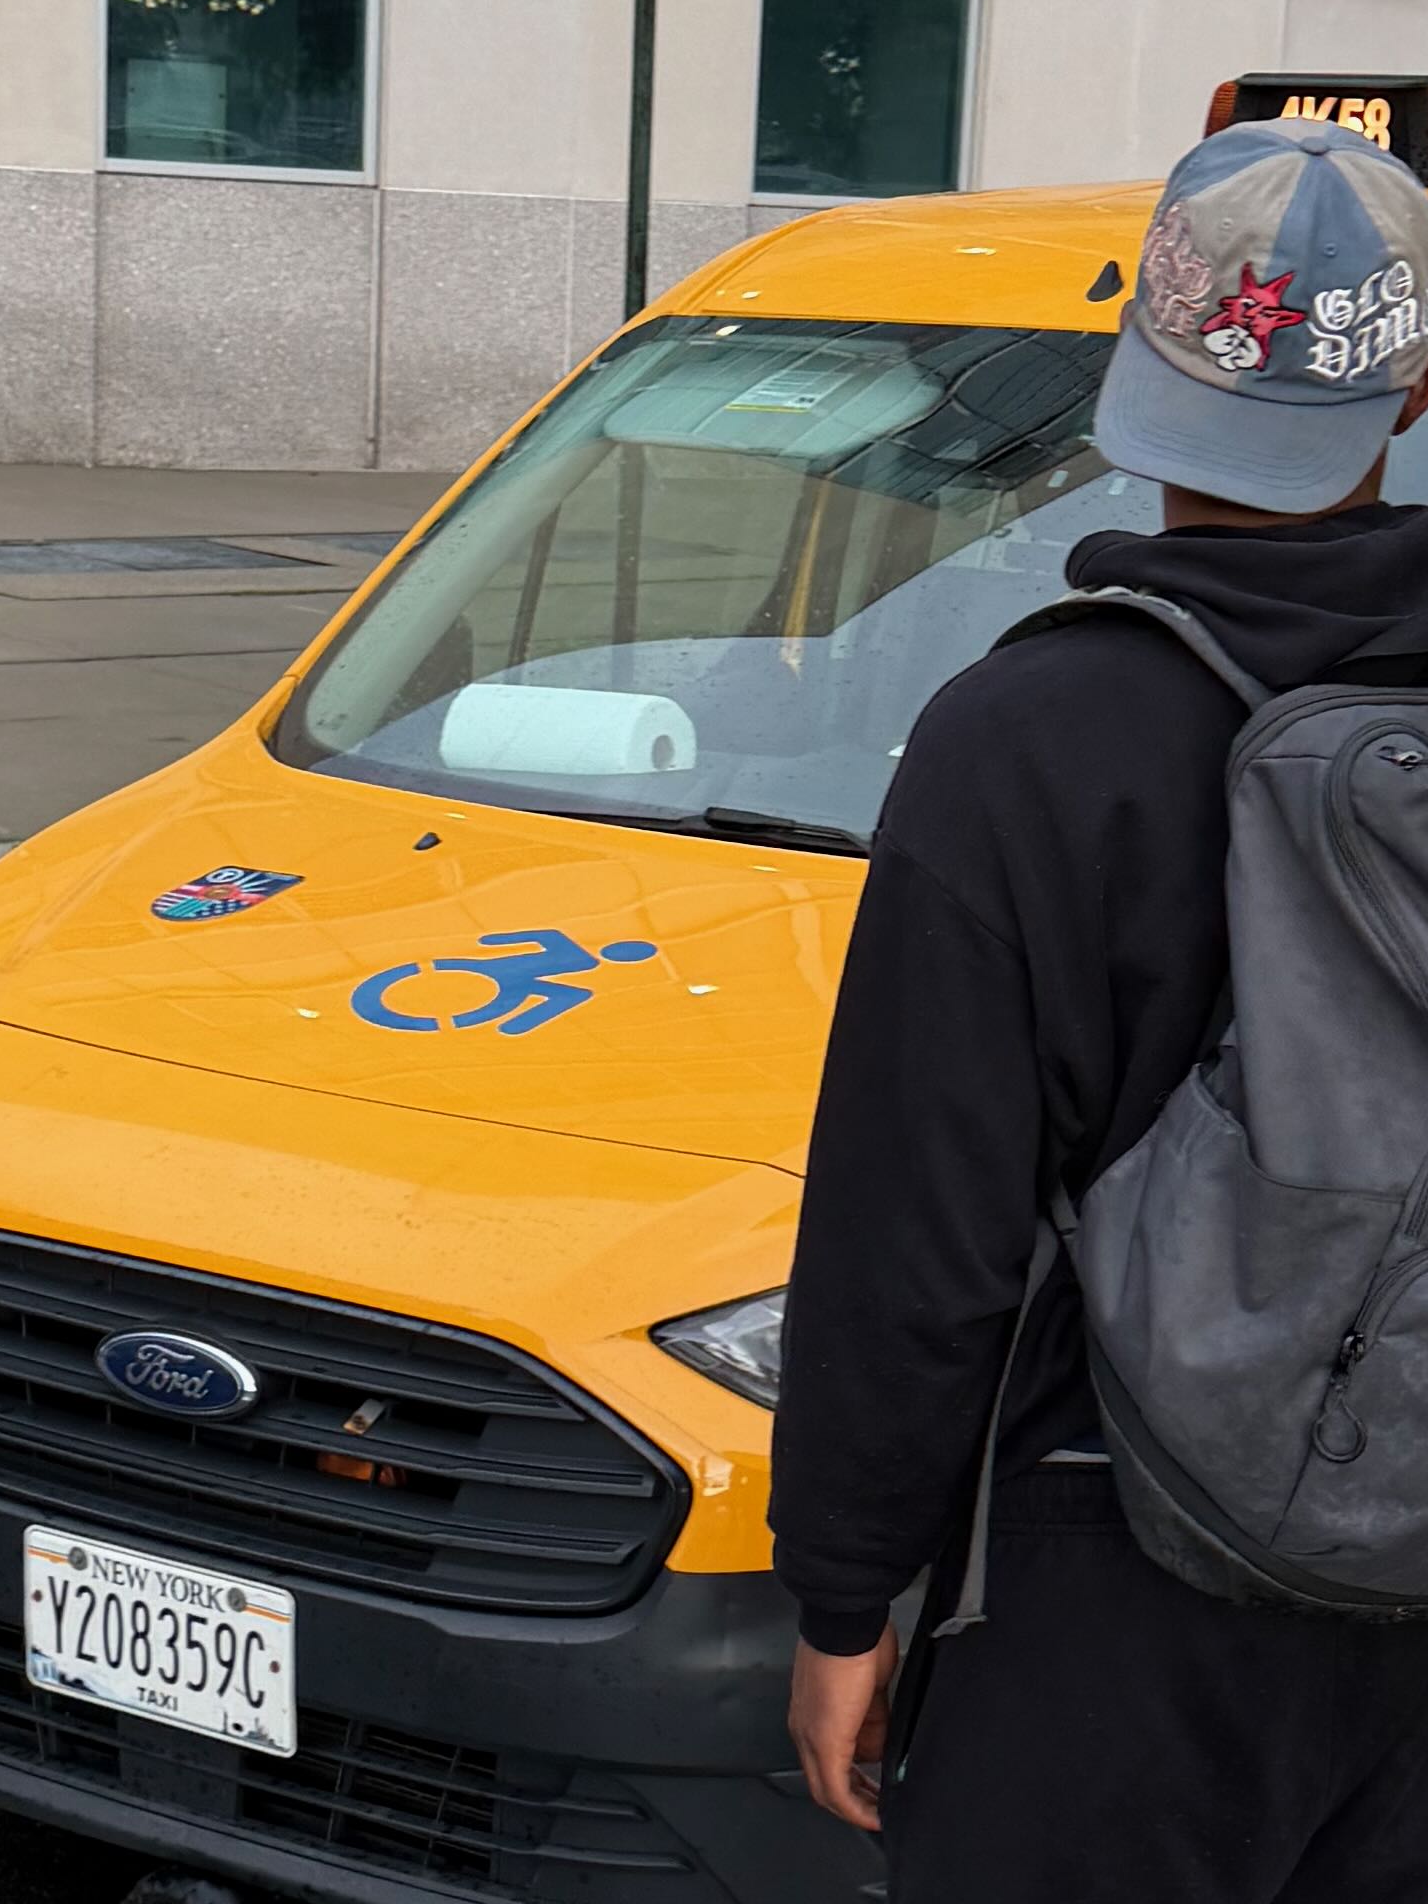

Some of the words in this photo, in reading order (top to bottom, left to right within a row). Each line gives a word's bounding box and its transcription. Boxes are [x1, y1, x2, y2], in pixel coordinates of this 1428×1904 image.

[125, 1343, 215, 1399] Ford
[91, 1554, 151, 1592] NEW
[154, 1570, 226, 1614] YORK
[47, 1575, 266, 1709] Y208359C
[136, 1686, 180, 1712] TAXI
